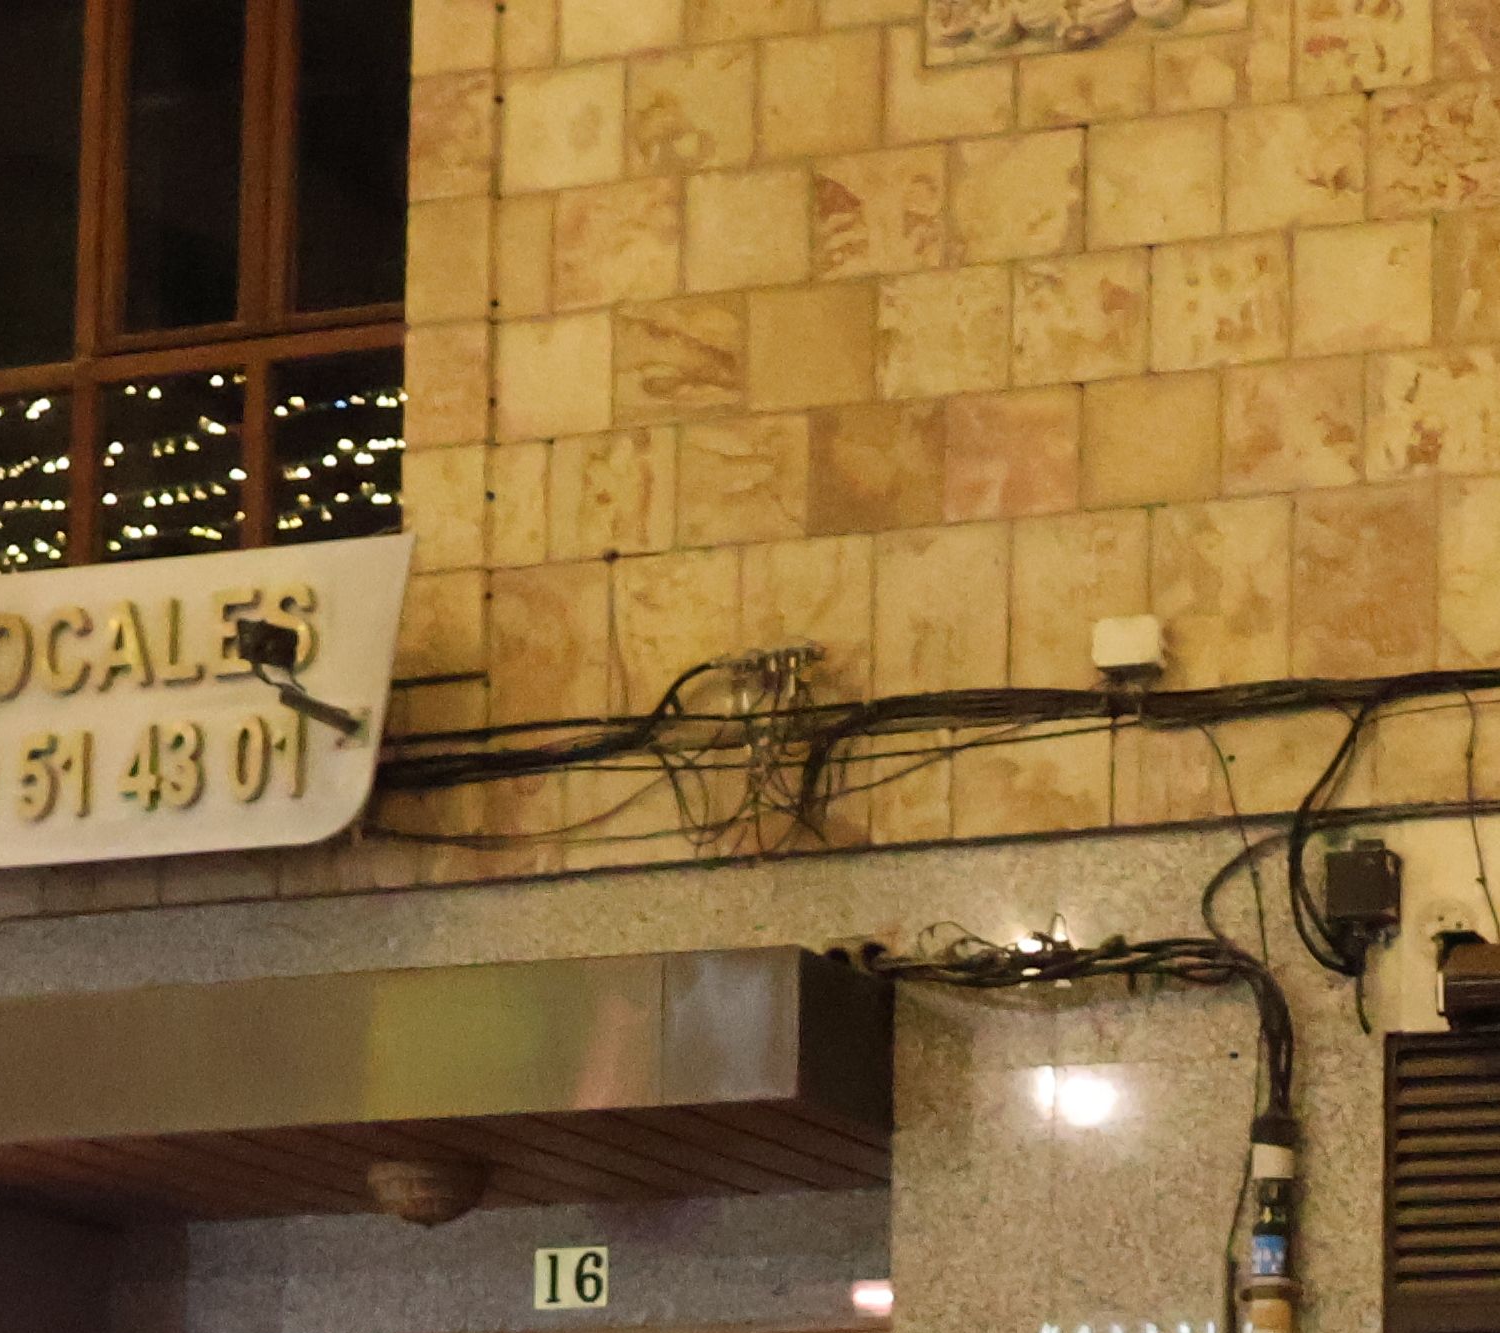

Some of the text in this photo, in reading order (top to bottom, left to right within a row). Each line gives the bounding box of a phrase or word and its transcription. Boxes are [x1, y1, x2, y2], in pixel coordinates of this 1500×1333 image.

[17, 731, 94, 820] 51
[117, 718, 205, 812] 43
[228, 712, 306, 801] 01
[546, 1252, 603, 1303] 16
